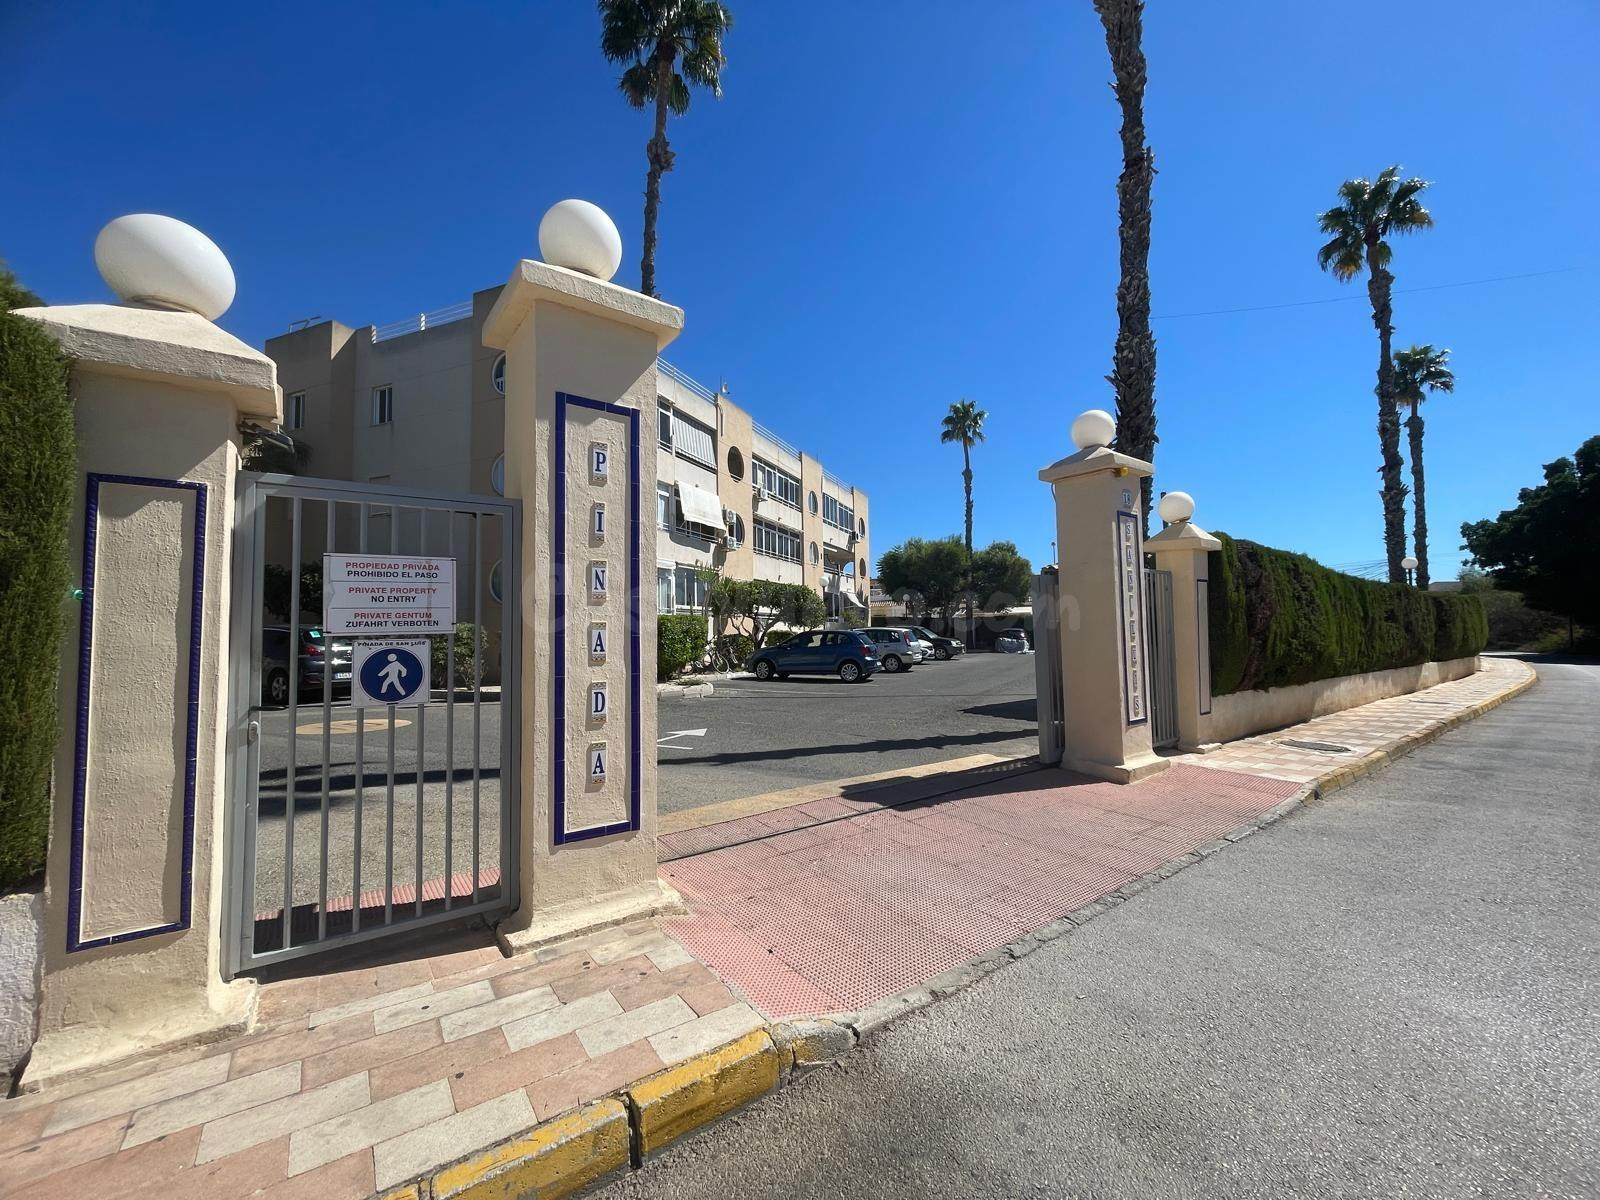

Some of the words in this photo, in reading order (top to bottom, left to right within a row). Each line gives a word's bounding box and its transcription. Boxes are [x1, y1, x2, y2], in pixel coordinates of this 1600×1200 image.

[345, 562, 400, 570] PROPIEDAD
[402, 563, 440, 571] PRIVADA
[347, 570, 399, 578] PROHIBIDO
[387, 595, 417, 603] ENTRY
